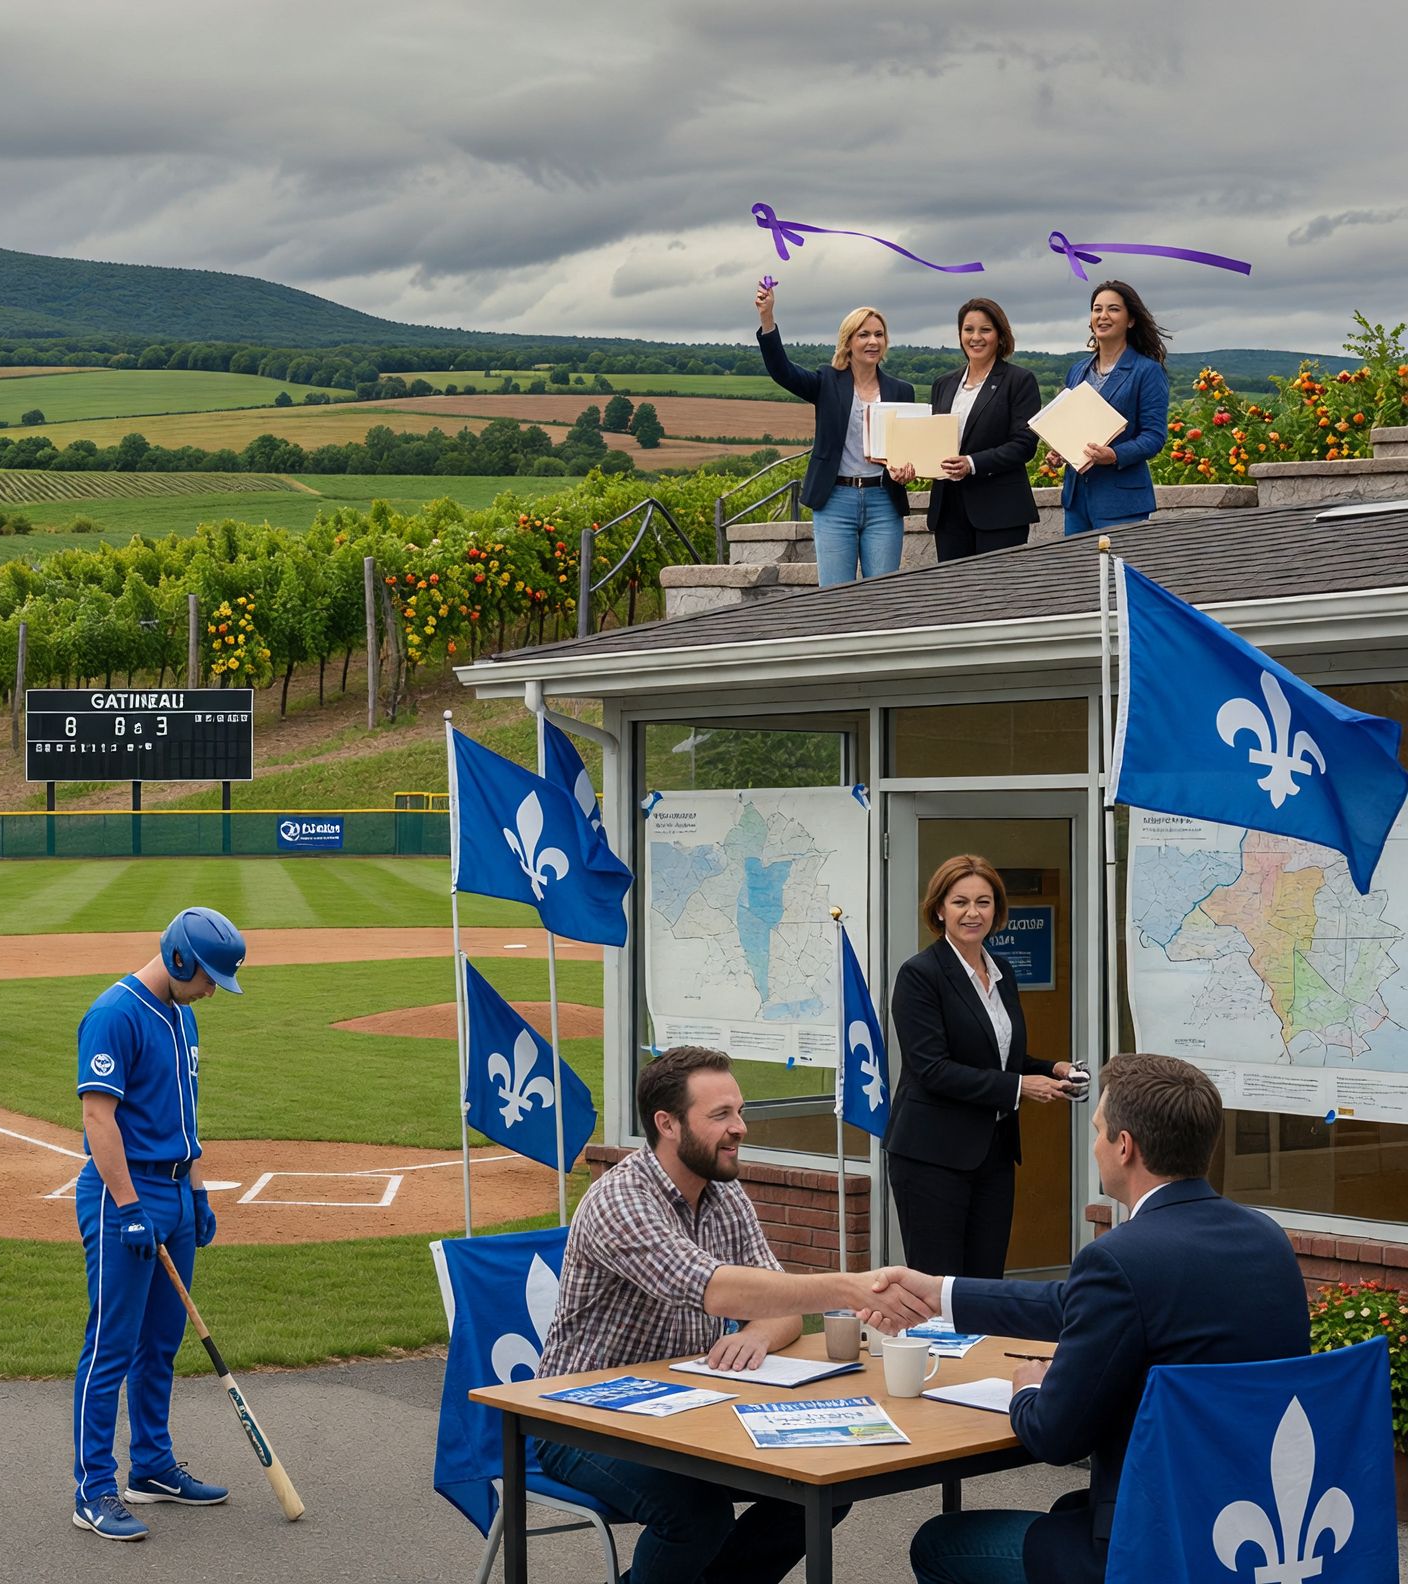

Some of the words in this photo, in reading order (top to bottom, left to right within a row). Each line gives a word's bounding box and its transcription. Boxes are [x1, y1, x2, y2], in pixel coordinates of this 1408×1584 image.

[91, 693, 184, 709] GATINEAU
[65, 716, 77, 737] 8
[156, 716, 168, 736] 3
